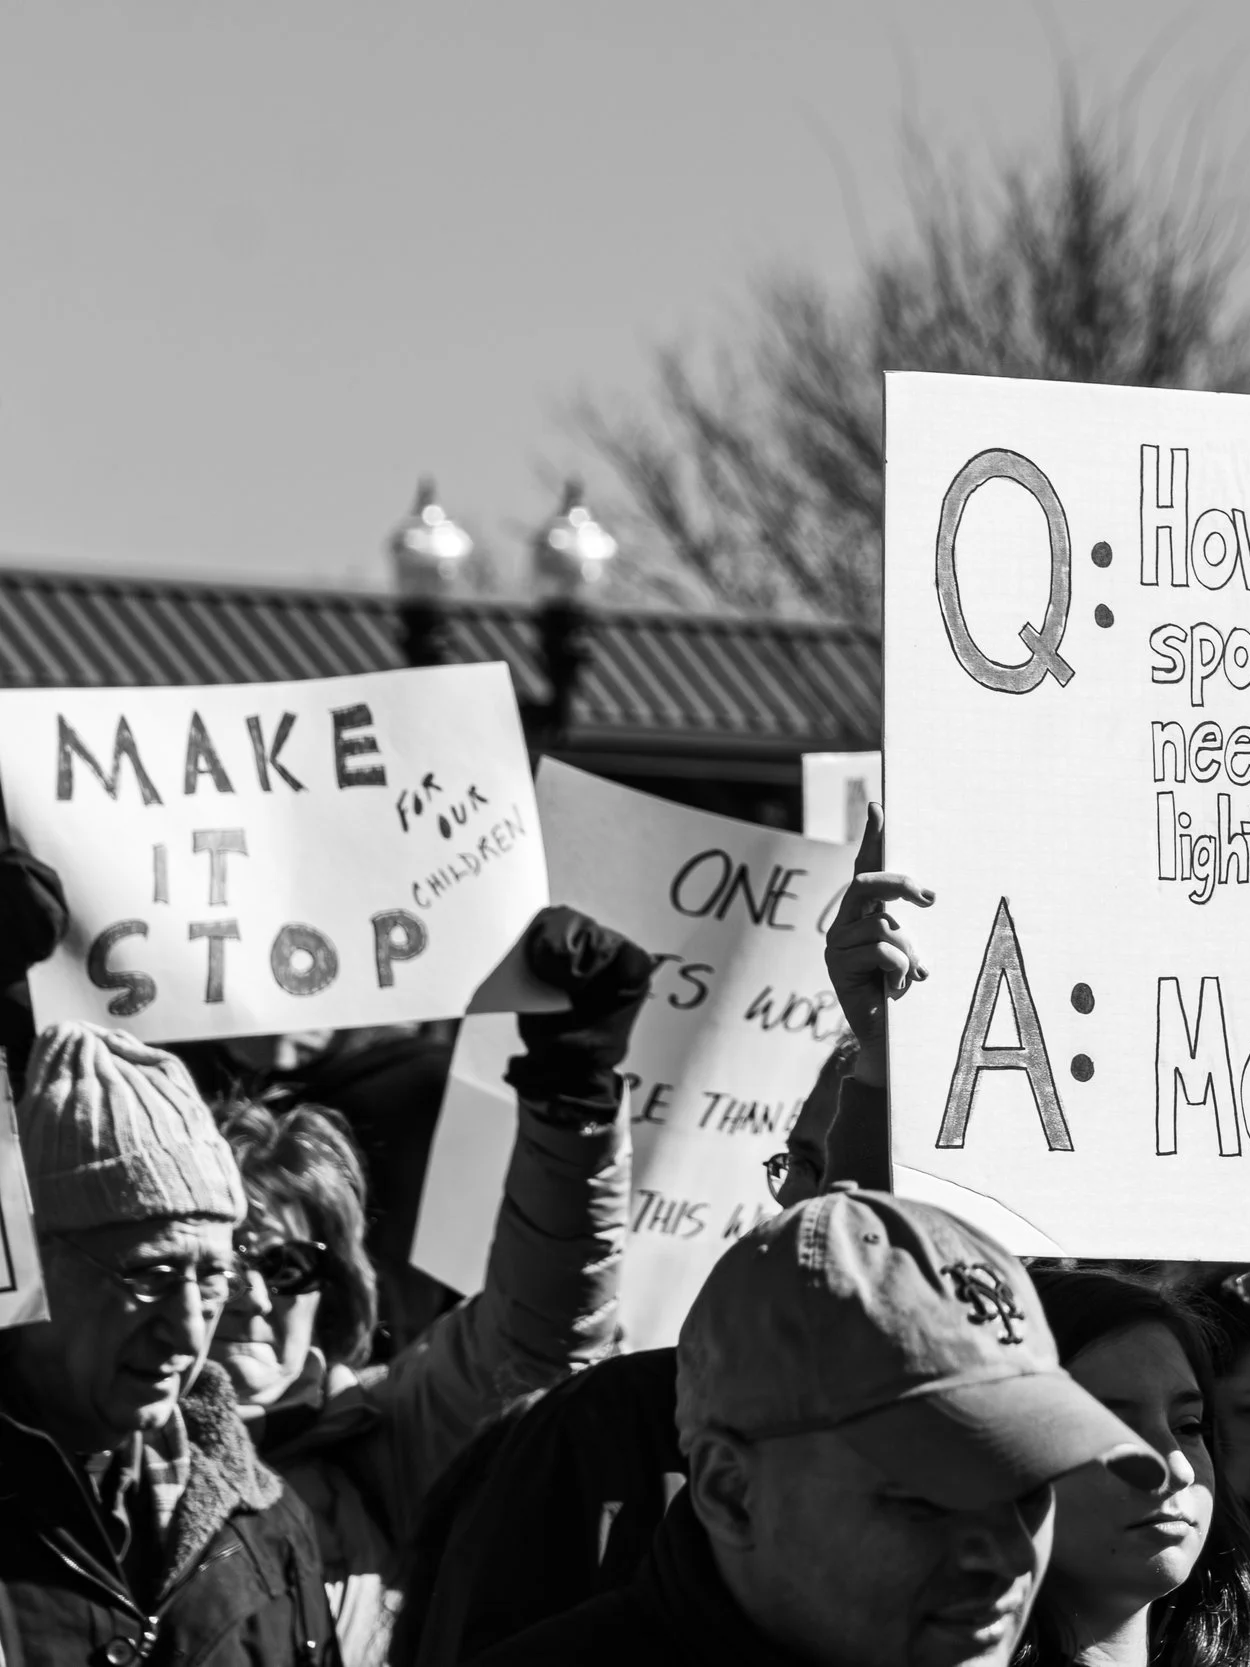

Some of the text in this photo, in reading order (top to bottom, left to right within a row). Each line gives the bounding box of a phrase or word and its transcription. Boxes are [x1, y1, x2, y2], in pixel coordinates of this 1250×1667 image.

[935, 448, 1114, 695] Q:
[57, 703, 388, 806] MAKE
[396, 772, 443, 833] FOR
[437, 784, 488, 840] OUR
[152, 828, 249, 907] IT
[411, 803, 526, 909] CHILDREN
[669, 848, 806, 929] ONE
[87, 909, 427, 1017] STOP
[934, 895, 1096, 1153] A:
[699, 1091, 785, 1136] THAN
[632, 1188, 711, 1239] THIS
